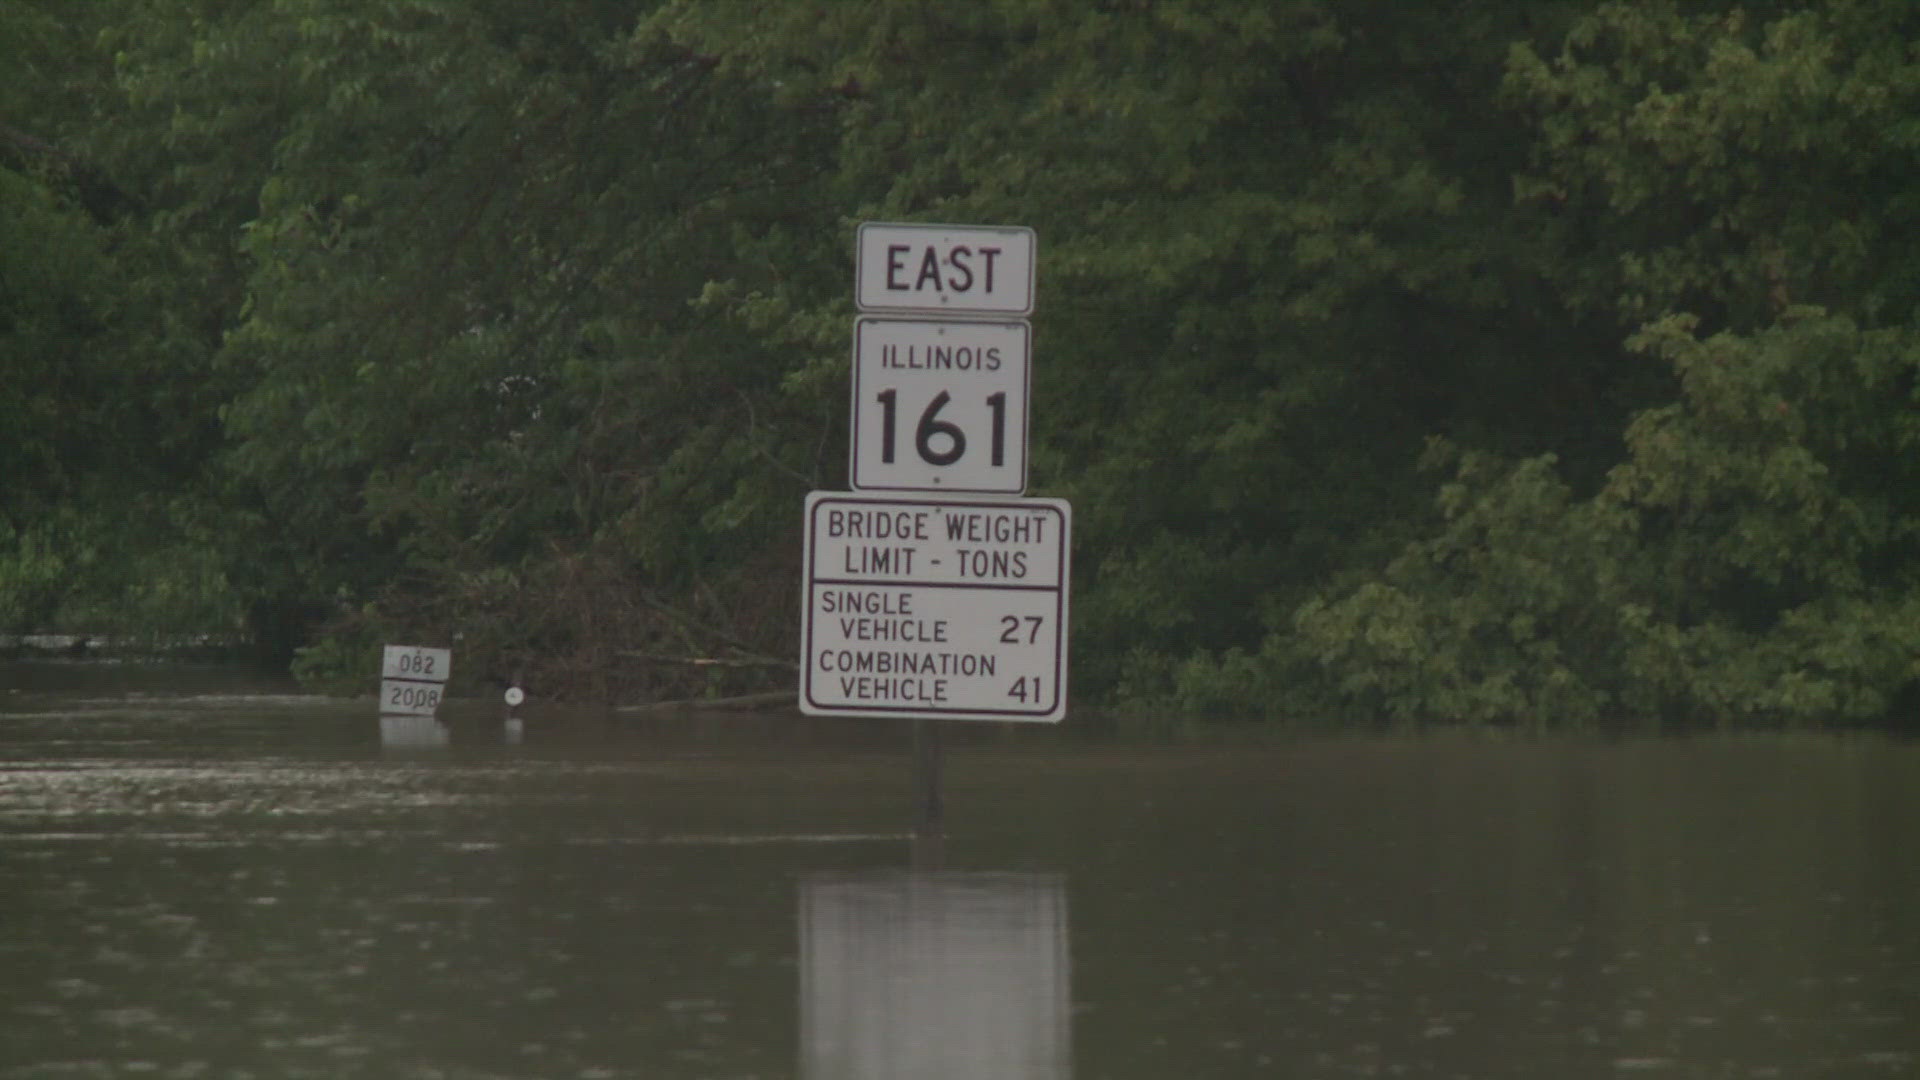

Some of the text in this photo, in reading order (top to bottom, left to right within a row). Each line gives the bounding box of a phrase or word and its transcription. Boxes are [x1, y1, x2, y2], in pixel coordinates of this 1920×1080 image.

[886, 245, 1002, 294] EAST
[882, 344, 1001, 370] ILLINOIS
[877, 389, 1006, 467] 161
[829, 511, 1047, 543] BRIDGE WEIGHT
[845, 546, 916, 575] LIMIT
[957, 549, 1028, 579] TONS
[822, 591, 912, 614] SINGLE
[841, 615, 1043, 644] VEHICLE 27
[400, 654, 434, 674] 082
[820, 650, 995, 676] COMBINATION
[391, 687, 438, 708] 2008
[841, 677, 1040, 703] VEHICLE 41
